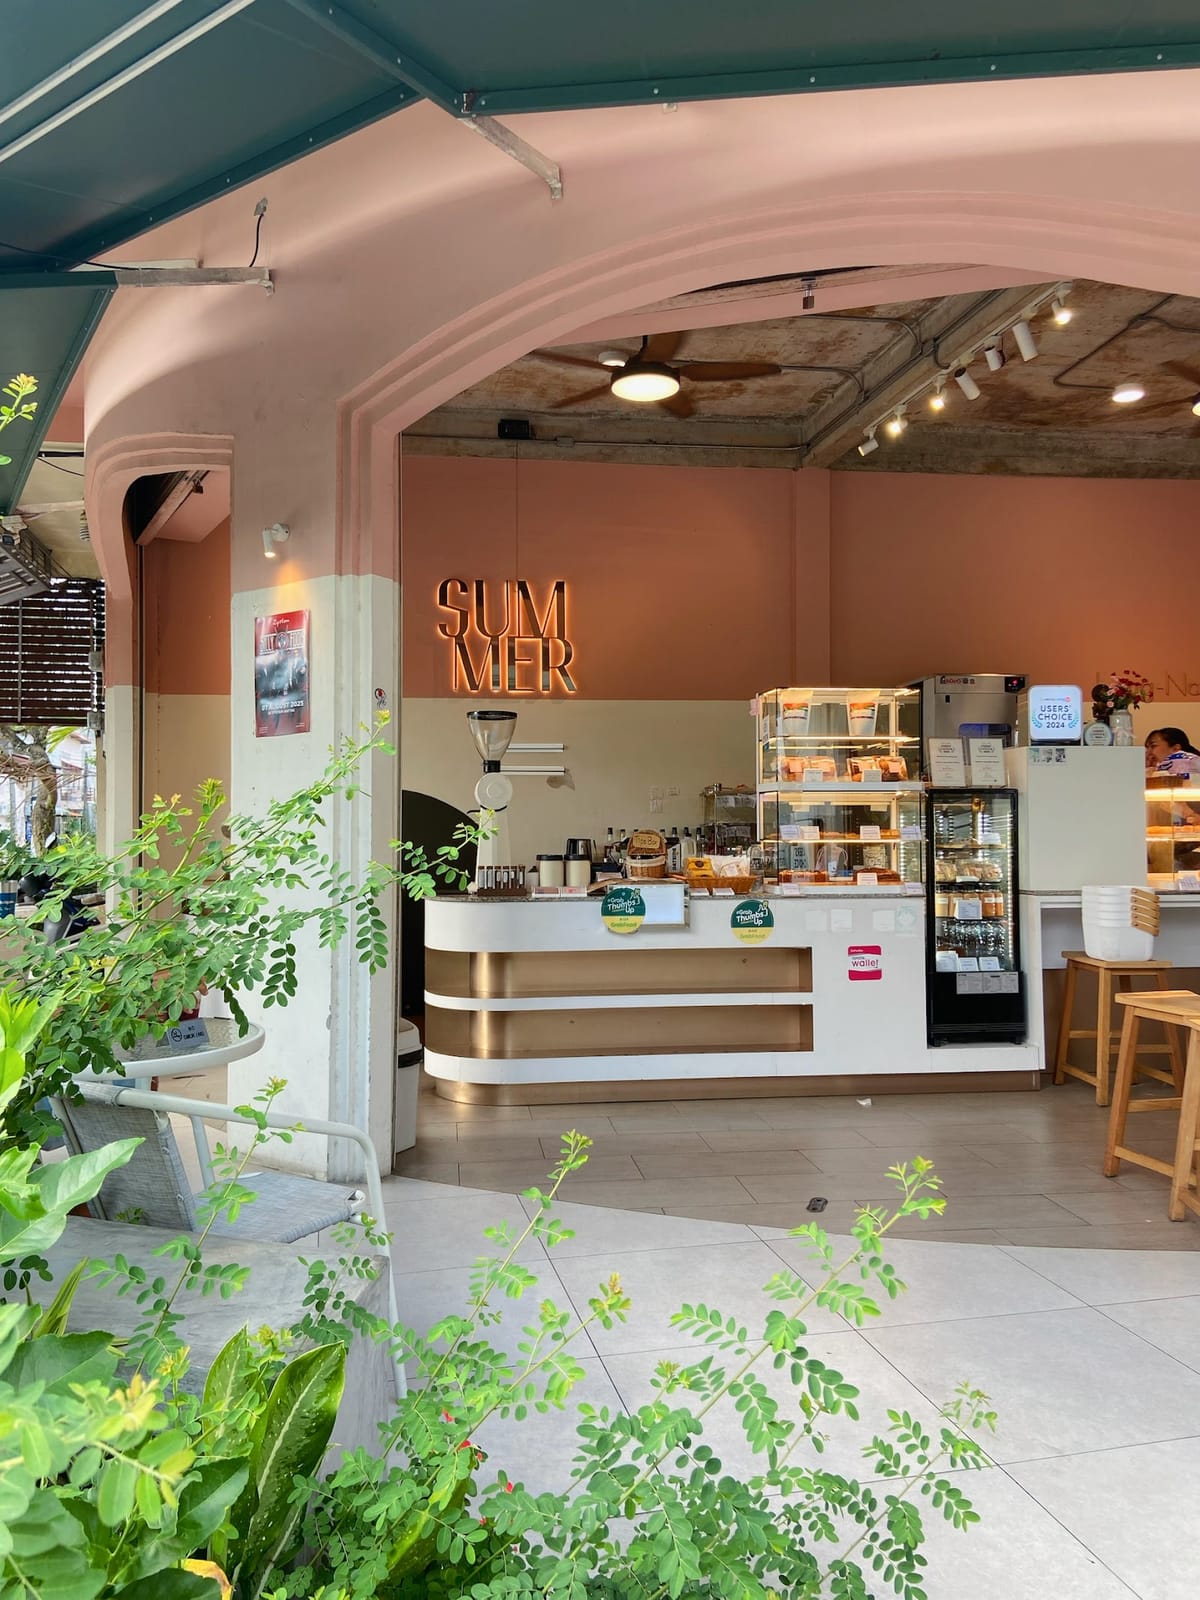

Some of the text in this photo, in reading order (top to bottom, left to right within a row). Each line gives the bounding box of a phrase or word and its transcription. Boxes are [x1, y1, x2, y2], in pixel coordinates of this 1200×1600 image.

[438, 578, 566, 637] SUM
[453, 635, 577, 692] MER
[1037, 713, 1073, 721] CHOICE
[1046, 721, 1065, 729] 2024
[608, 899, 636, 911] Thumbs
[625, 905, 635, 915] Up
[736, 911, 765, 923] Thumbs
[753, 916, 764, 926] Up
